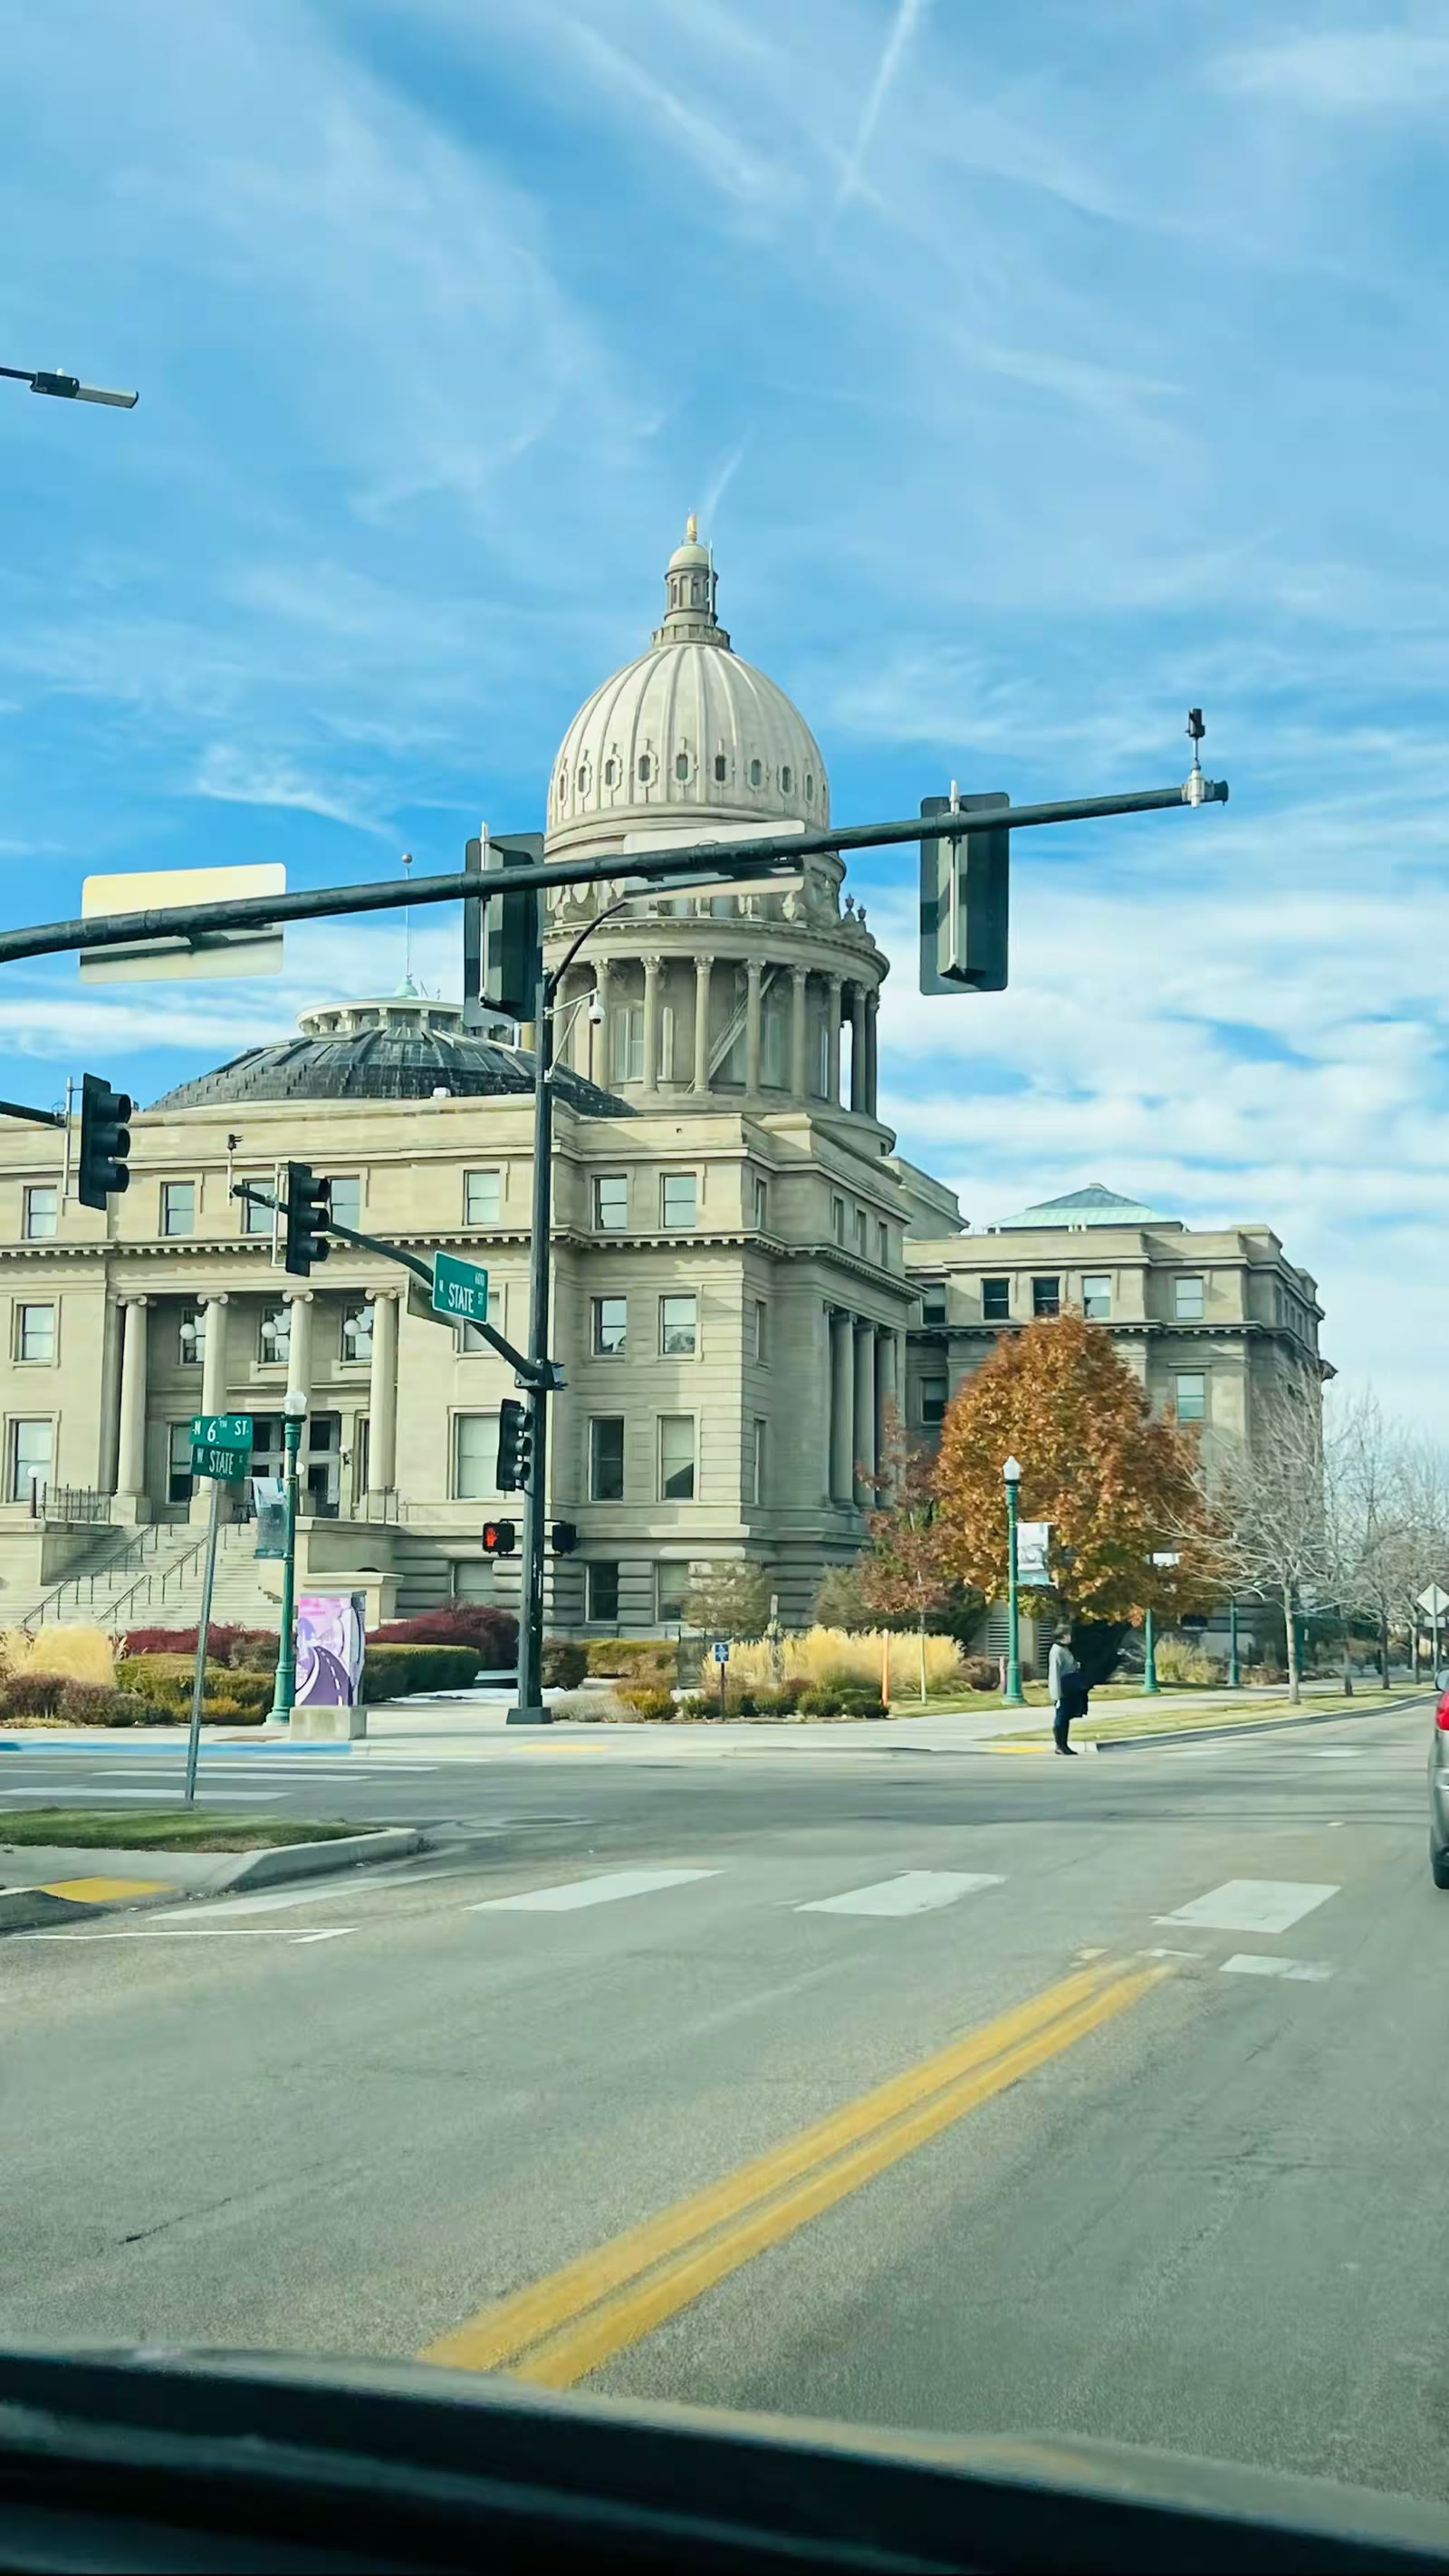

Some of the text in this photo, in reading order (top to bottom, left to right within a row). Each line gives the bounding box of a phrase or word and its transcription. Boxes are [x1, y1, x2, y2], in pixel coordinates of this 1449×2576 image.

[448, 1283, 475, 1313] STATE
[477, 1292, 484, 1305] ST
[194, 1420, 201, 1436] N
[209, 1449, 235, 1475] STATE
